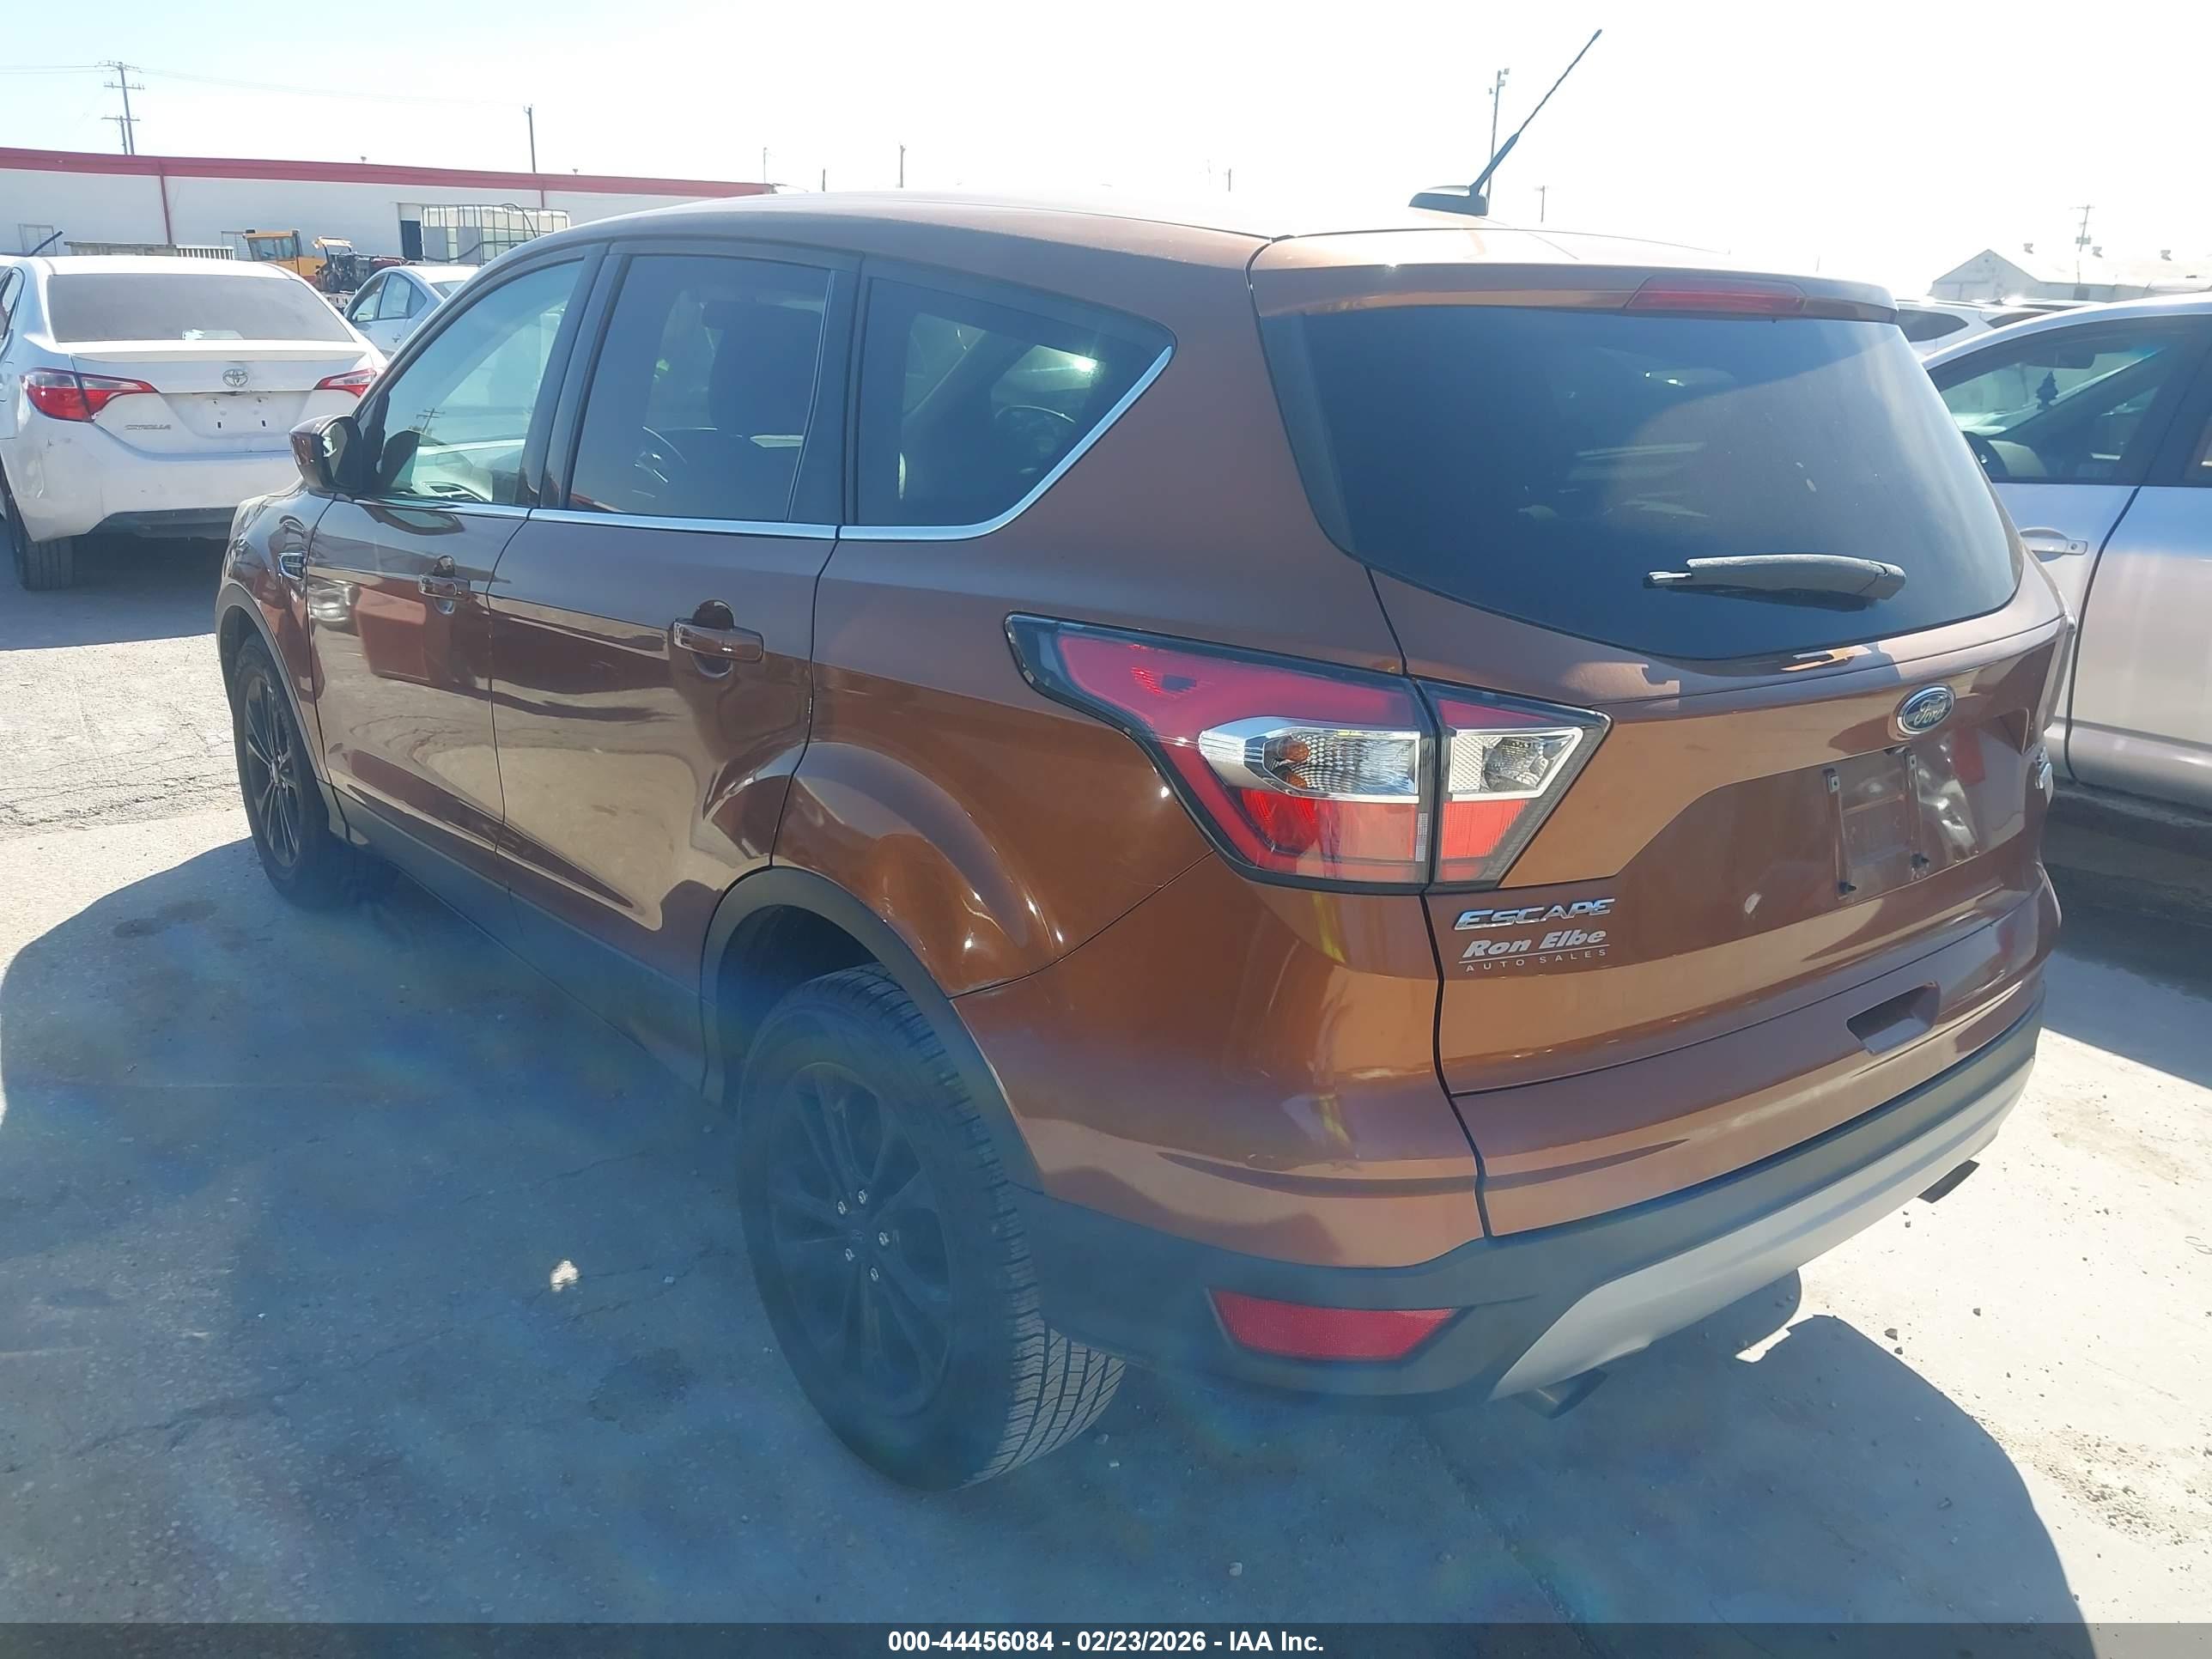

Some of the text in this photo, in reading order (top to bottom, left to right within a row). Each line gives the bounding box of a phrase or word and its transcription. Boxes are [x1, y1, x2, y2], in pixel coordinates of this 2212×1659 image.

[1914, 697, 1947, 725] Ford
[1454, 898, 1615, 931] ESCAPE
[1462, 929, 1607, 958] Ron Elbe
[1465, 949, 1607, 972] AUTO SALES
